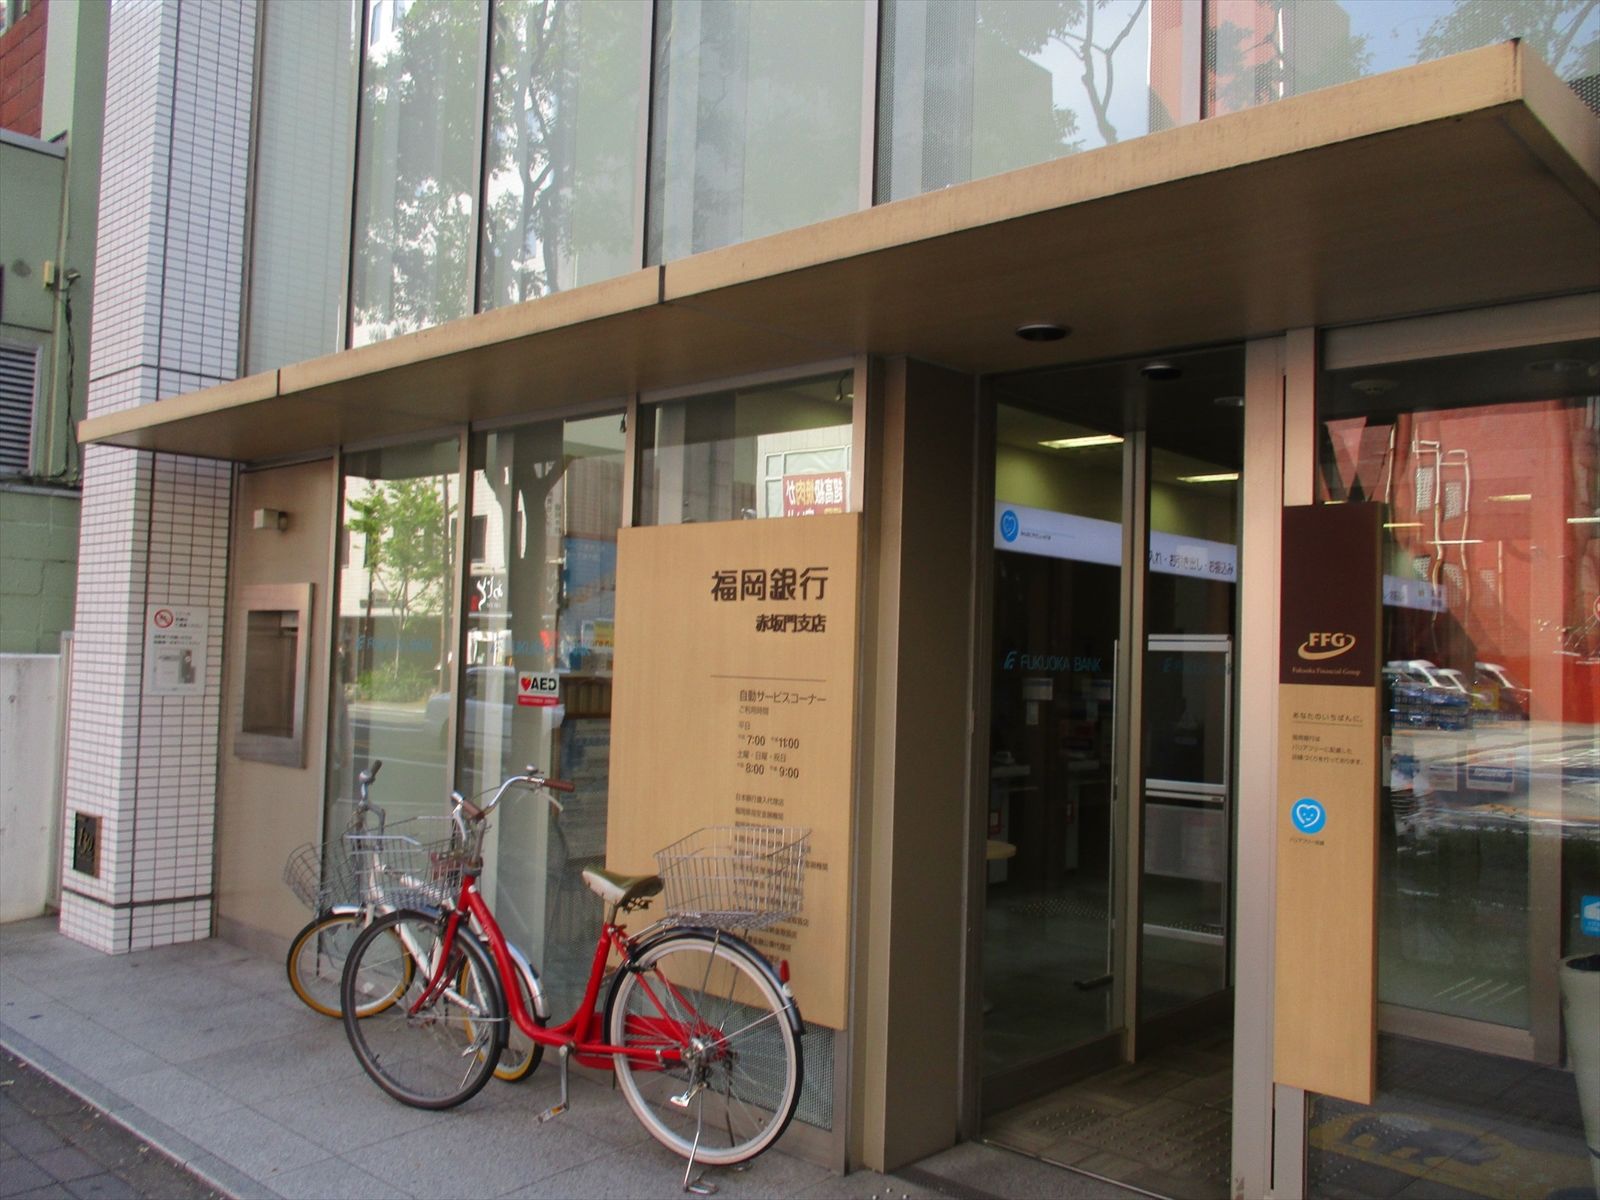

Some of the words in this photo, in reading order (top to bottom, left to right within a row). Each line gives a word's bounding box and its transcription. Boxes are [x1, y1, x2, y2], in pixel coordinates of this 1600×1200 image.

[711, 567, 829, 602] 福岡銀行
[756, 613, 826, 634] 赤坂門支店
[1308, 632, 1346, 648] FFG
[1020, 654, 1070, 671] FUKUOKA
[1073, 656, 1103, 673] BANK
[531, 677, 557, 691] AED
[739, 690, 827, 705] 自動サービスコーナー
[747, 735, 766, 746] 7:00
[779, 737, 800, 750] 11:00
[745, 762, 765, 775] 8:00
[779, 766, 799, 779] 9:00
